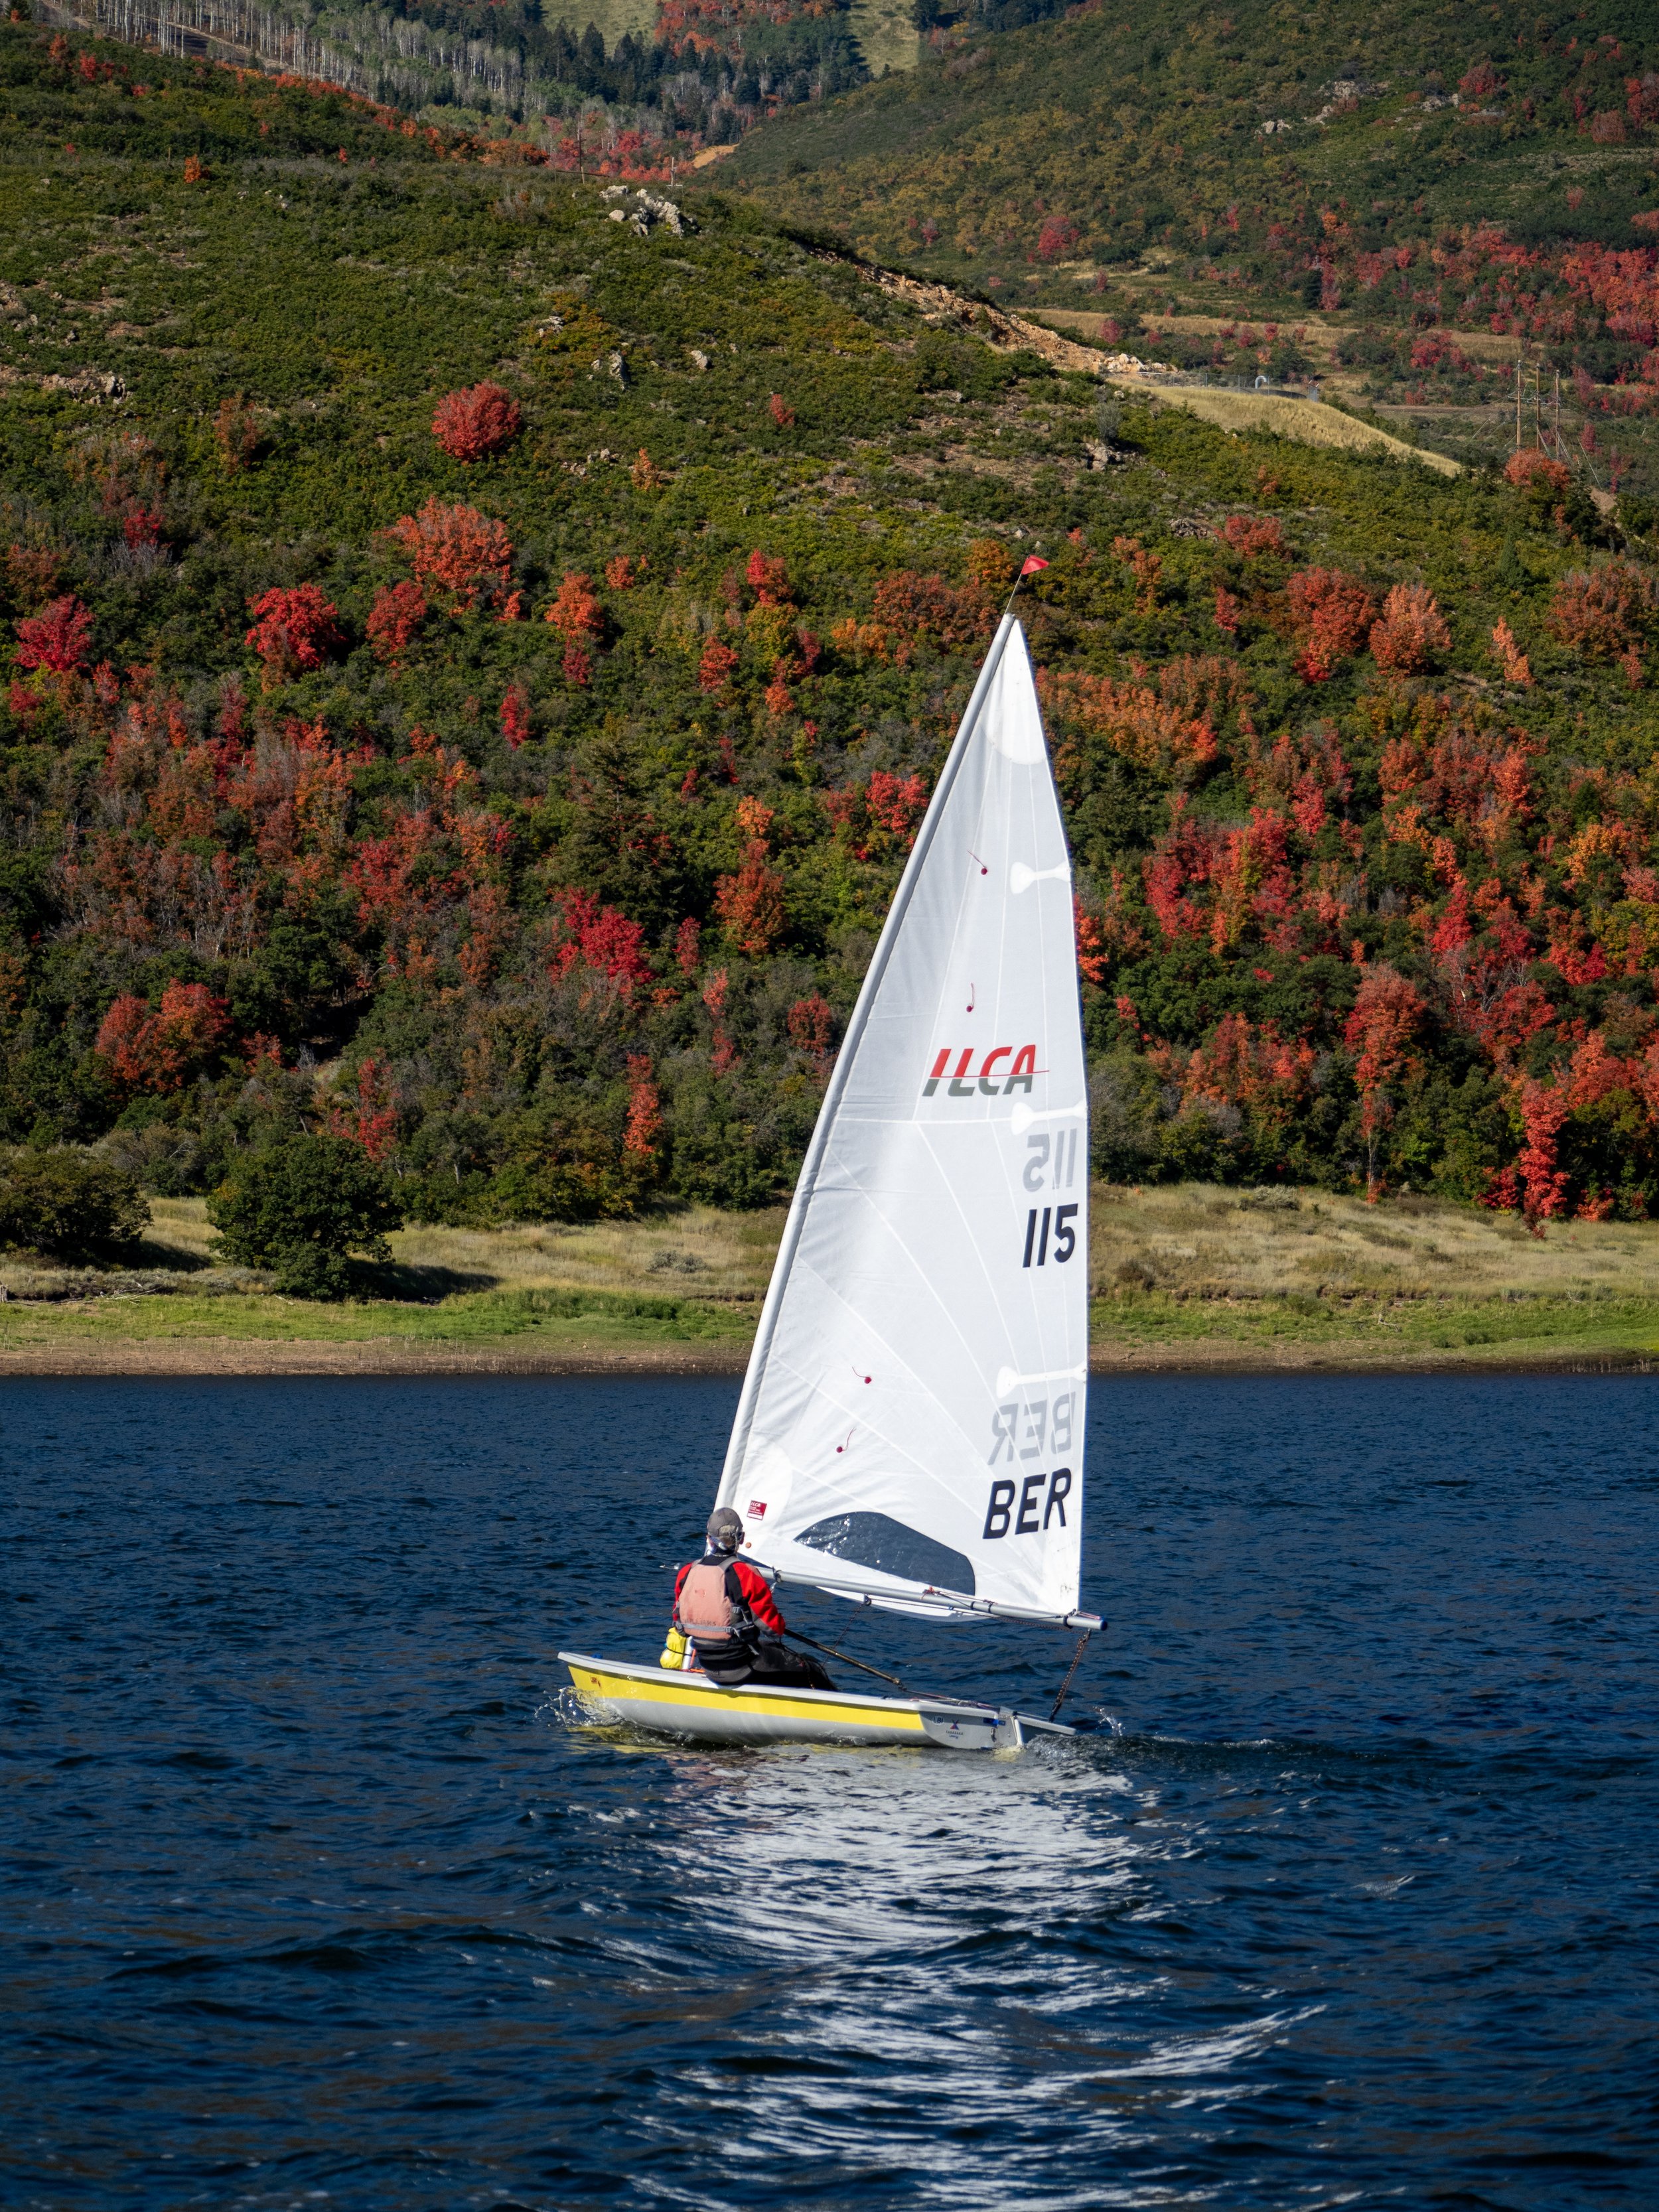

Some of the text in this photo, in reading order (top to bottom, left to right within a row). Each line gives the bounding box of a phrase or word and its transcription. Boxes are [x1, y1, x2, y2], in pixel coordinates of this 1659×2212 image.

[922, 1044, 1036, 1097] ILCA
[1023, 1204, 1078, 1268] 115
[982, 1467, 1072, 1539] BER
